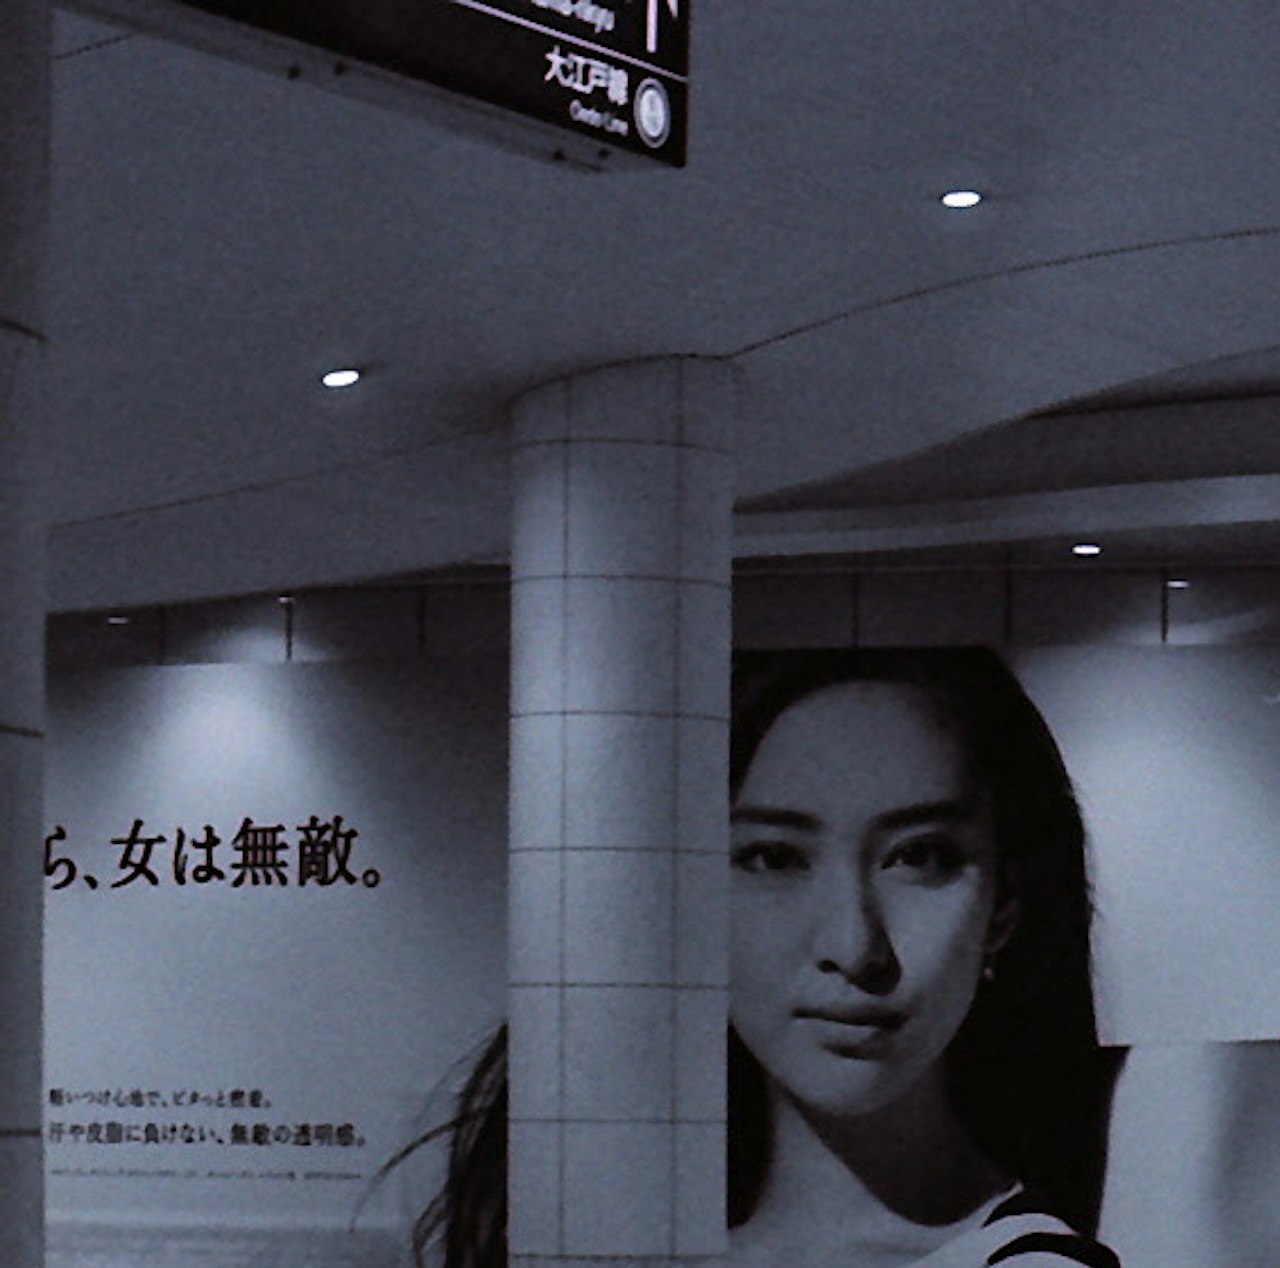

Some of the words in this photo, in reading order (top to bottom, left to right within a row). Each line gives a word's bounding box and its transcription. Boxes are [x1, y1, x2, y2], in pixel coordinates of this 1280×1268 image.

[43, 815, 381, 890] ら、女は無敵。
